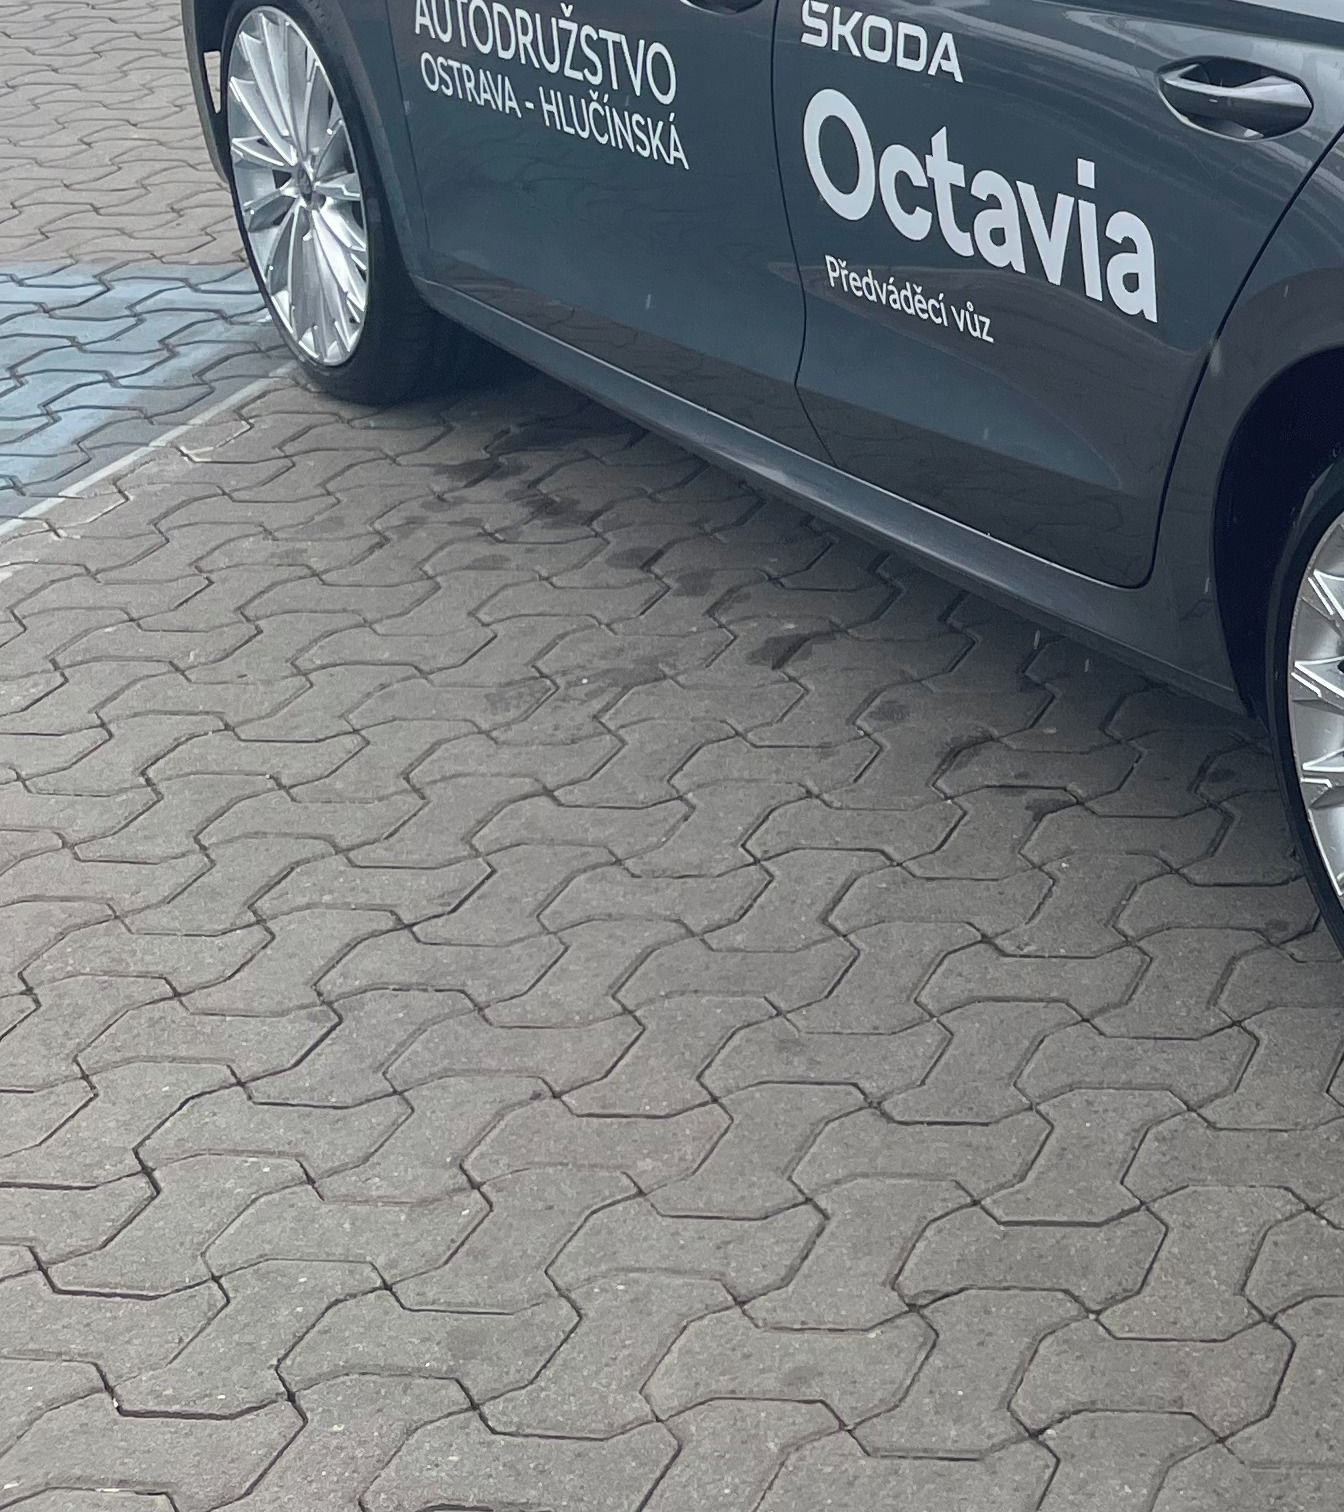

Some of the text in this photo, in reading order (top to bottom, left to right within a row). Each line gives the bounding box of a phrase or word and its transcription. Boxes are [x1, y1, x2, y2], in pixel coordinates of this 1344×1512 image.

[420, 52, 522, 119] OSTRAVA
[538, 86, 690, 170] HLUČÍNSKÁ
[803, 88, 1159, 324] Octavia
[824, 254, 995, 345] Předváděcí vůz
